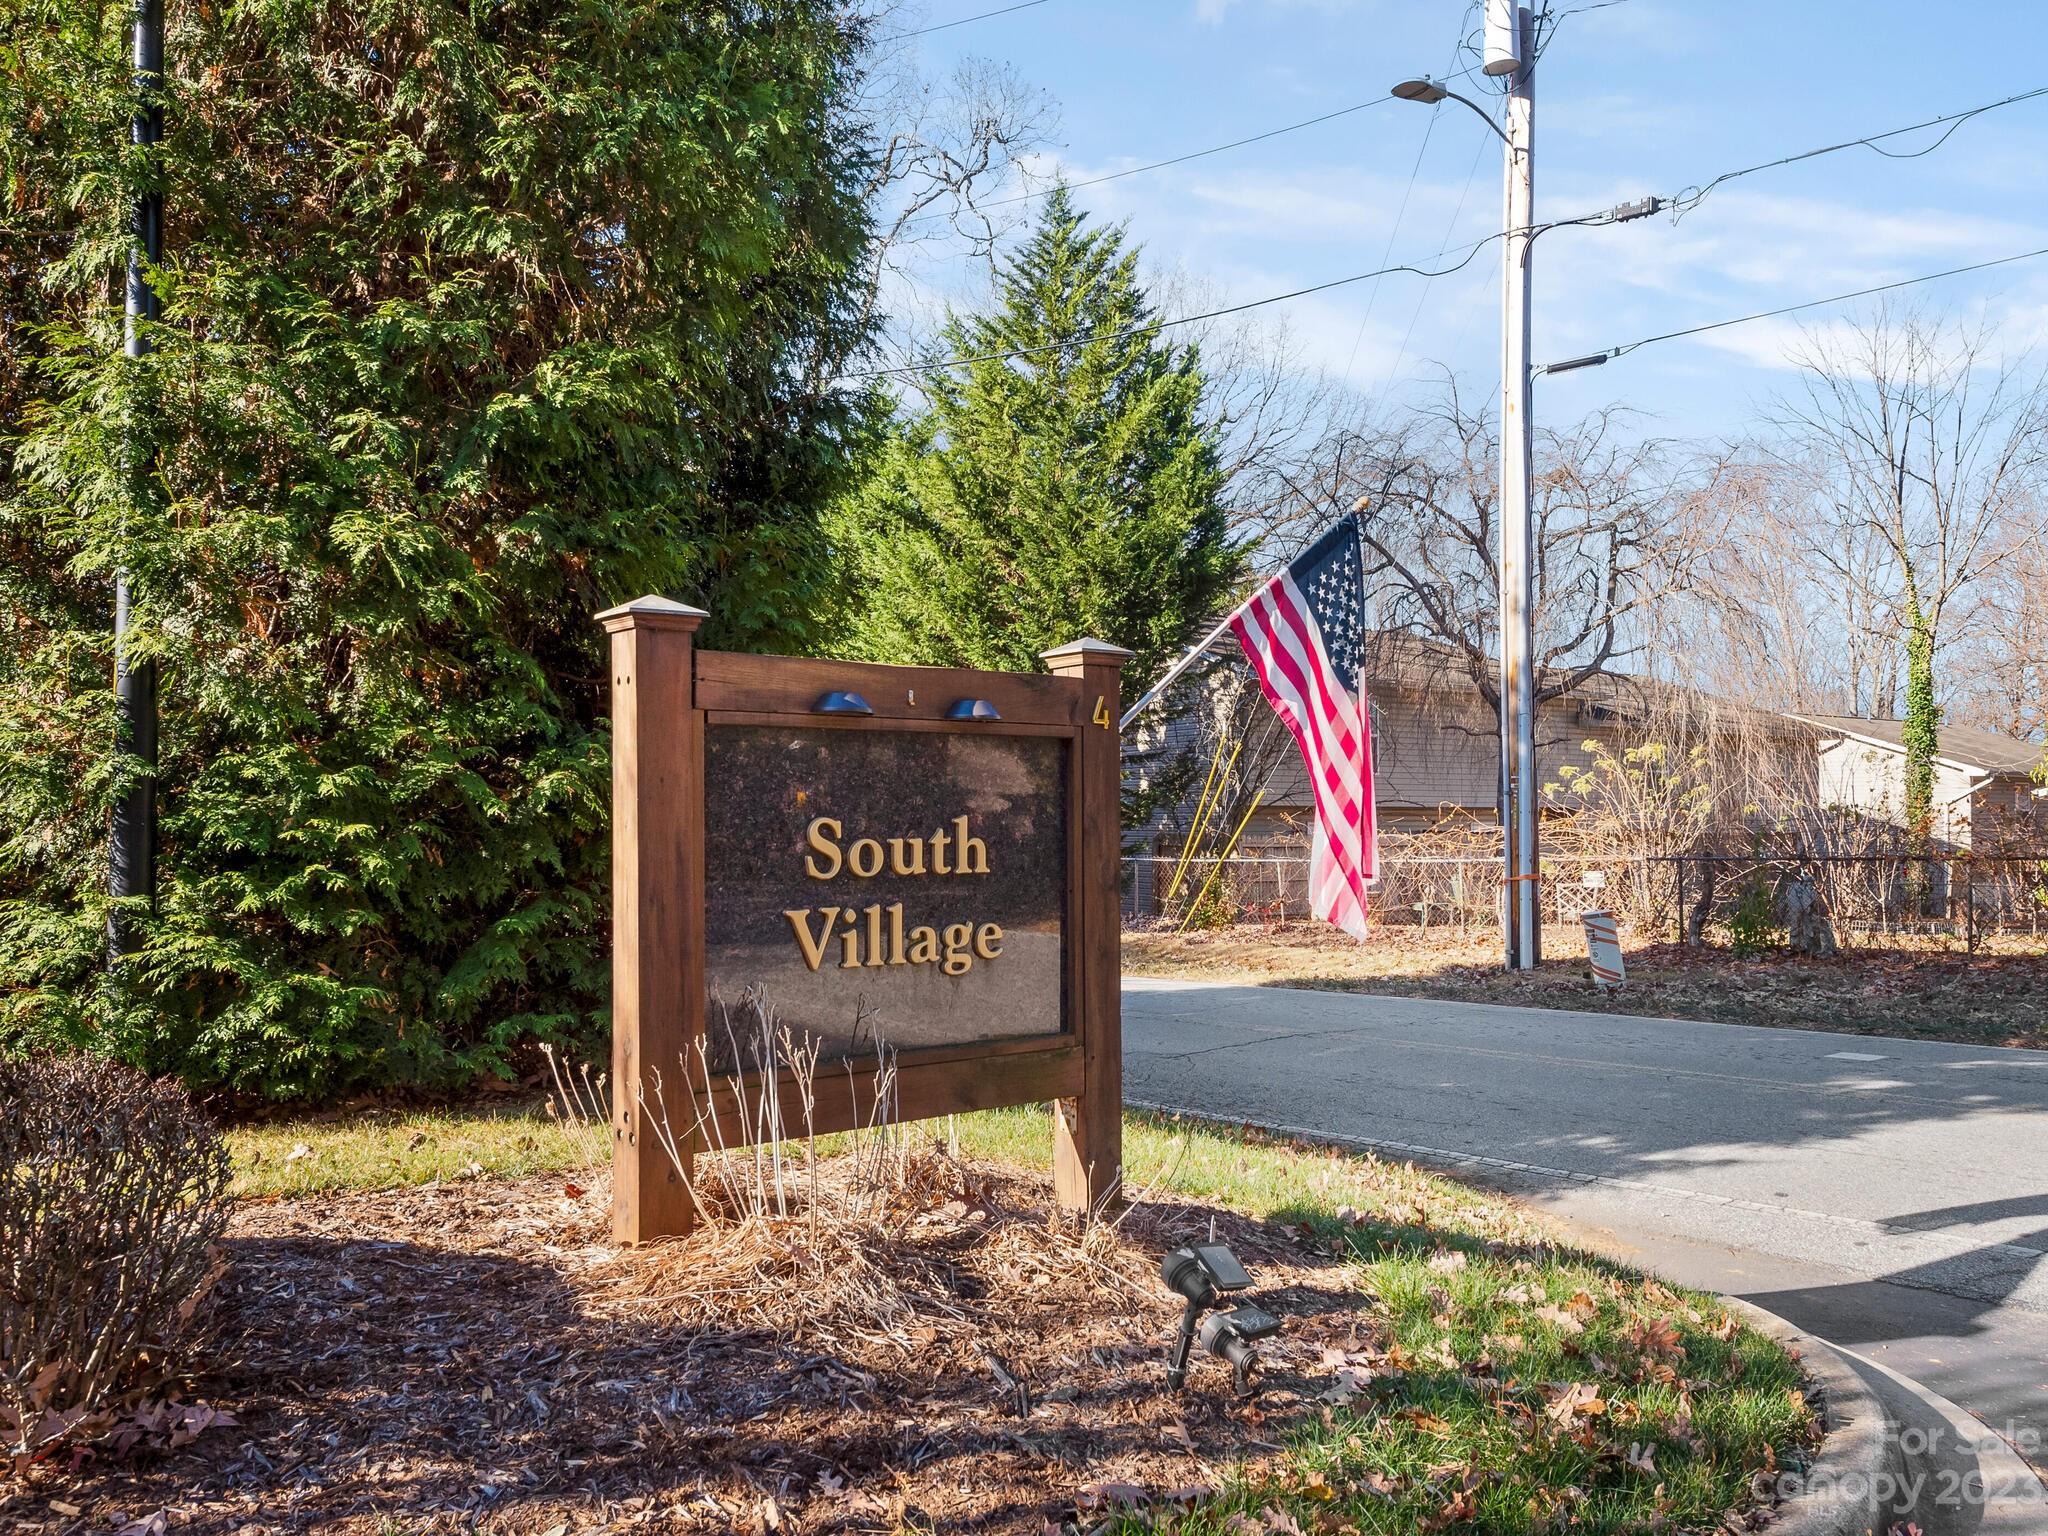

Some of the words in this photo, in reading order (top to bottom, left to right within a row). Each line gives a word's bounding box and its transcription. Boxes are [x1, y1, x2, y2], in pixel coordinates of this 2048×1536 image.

[1092, 695, 1110, 729] 4
[805, 815, 990, 880] South
[783, 902, 1003, 976] Village
